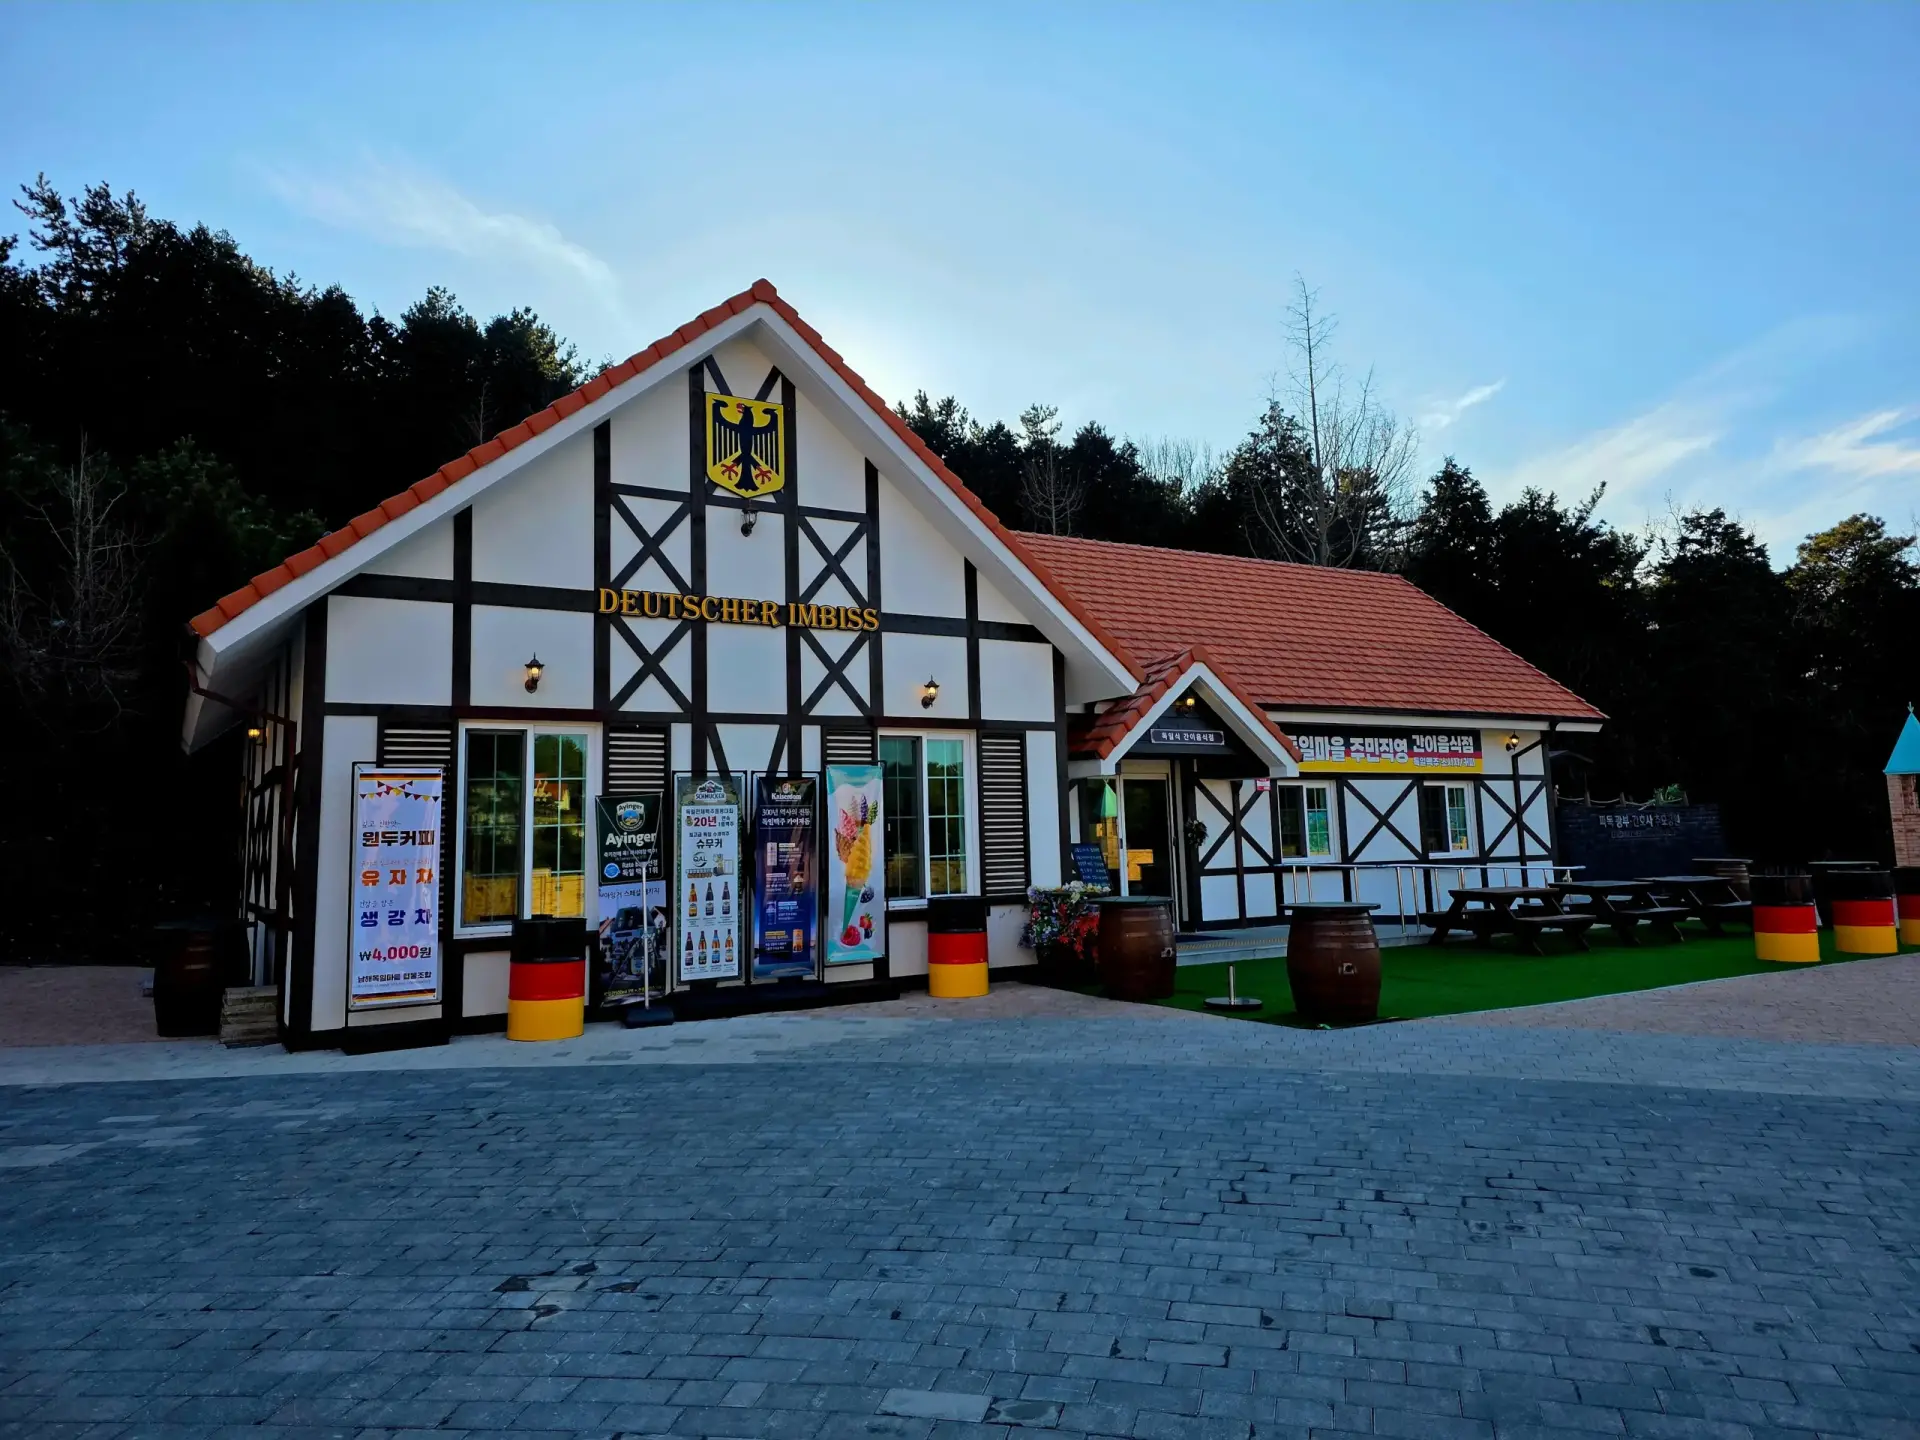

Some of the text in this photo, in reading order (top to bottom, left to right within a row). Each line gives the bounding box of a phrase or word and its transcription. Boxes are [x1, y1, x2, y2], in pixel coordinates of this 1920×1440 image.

[598, 587, 880, 631] DEUTSCHER IMBISS
[1161, 731, 1215, 742] 독일식 간이음식점
[1350, 736, 1409, 764] 주민직영
[1411, 734, 1474, 754] 간이음식점
[618, 803, 643, 811] Ayinger
[694, 815, 717, 828] 20년
[362, 829, 435, 847] 원두커피
[605, 831, 657, 848] Ayinger
[696, 838, 723, 849] 슈무커
